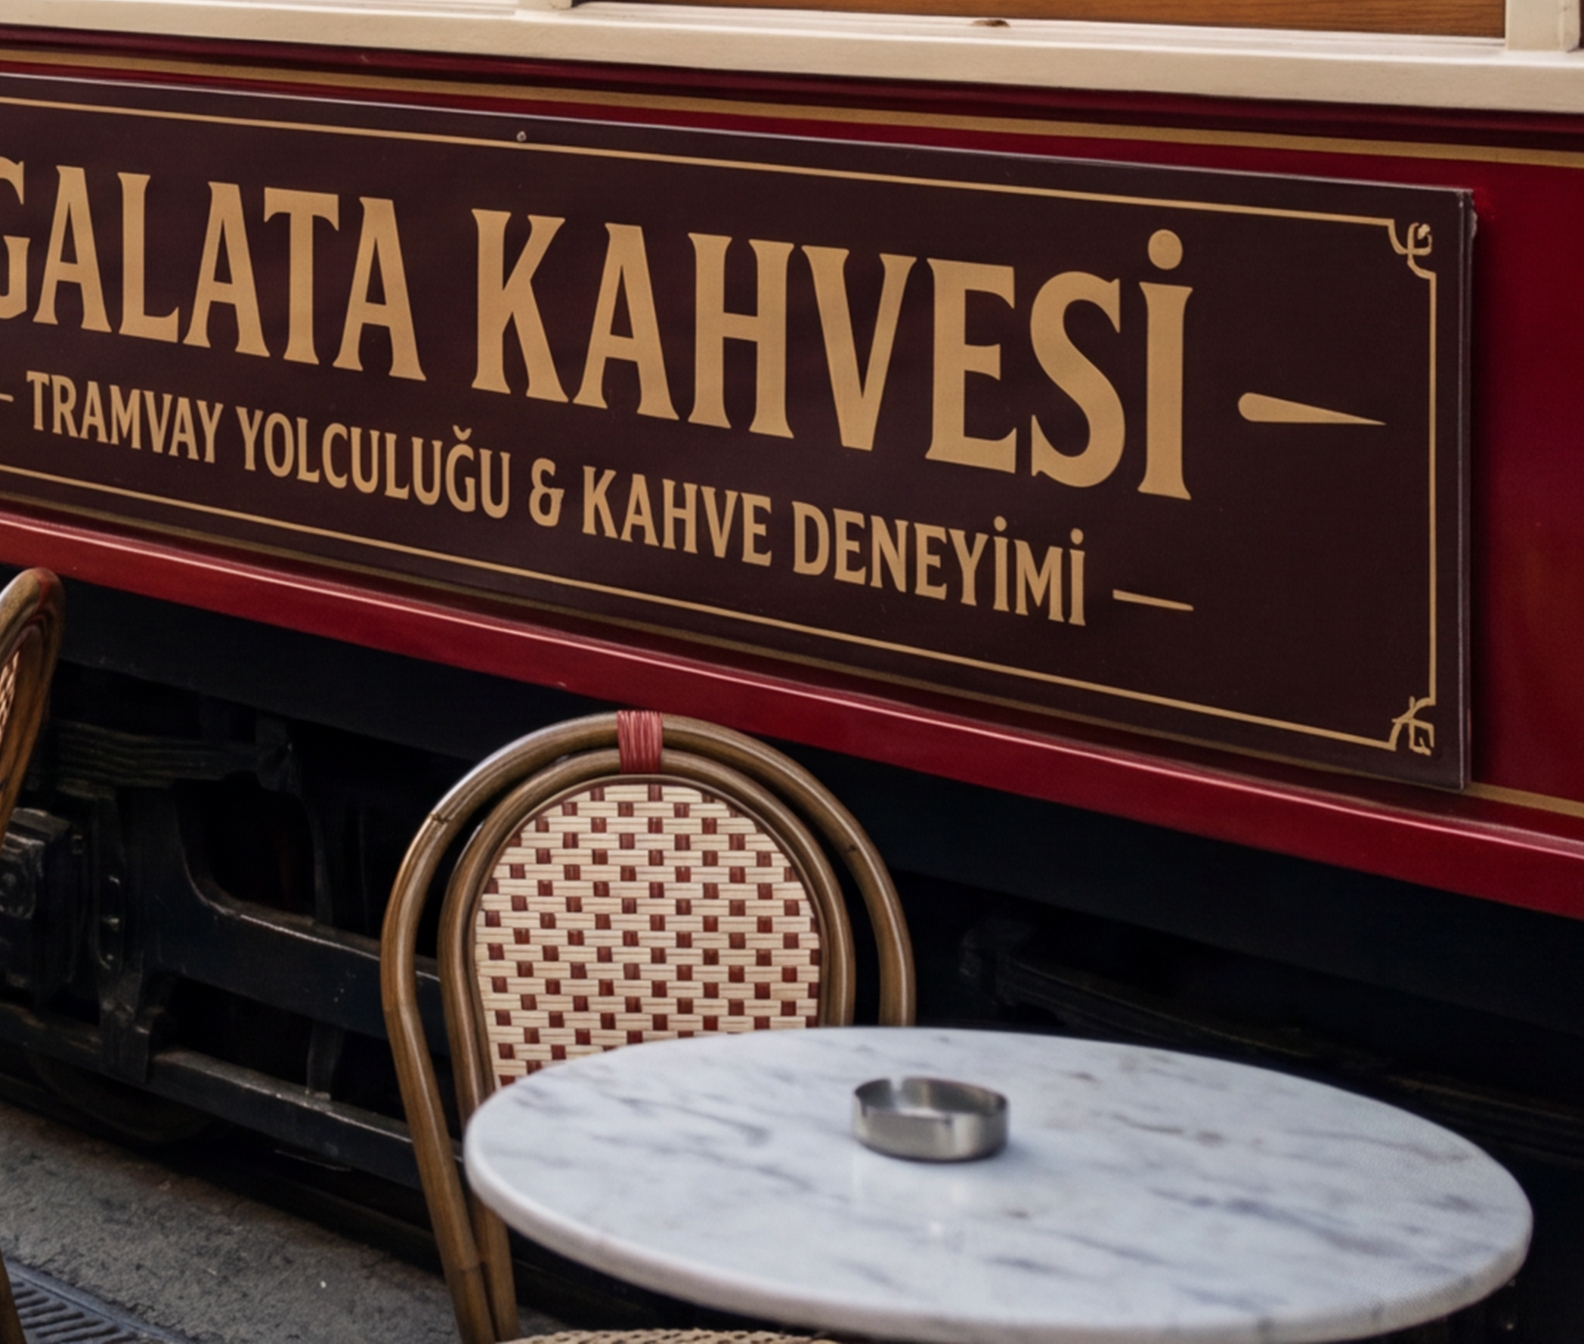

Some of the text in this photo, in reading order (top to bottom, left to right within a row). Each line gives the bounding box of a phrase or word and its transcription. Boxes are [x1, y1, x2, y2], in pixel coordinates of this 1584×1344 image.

[471, 208, 1194, 501] KAHVESİ
[25, 369, 1087, 626] TRAMVAY YOLCULUĞU & KAHVE DENEYİMİ
